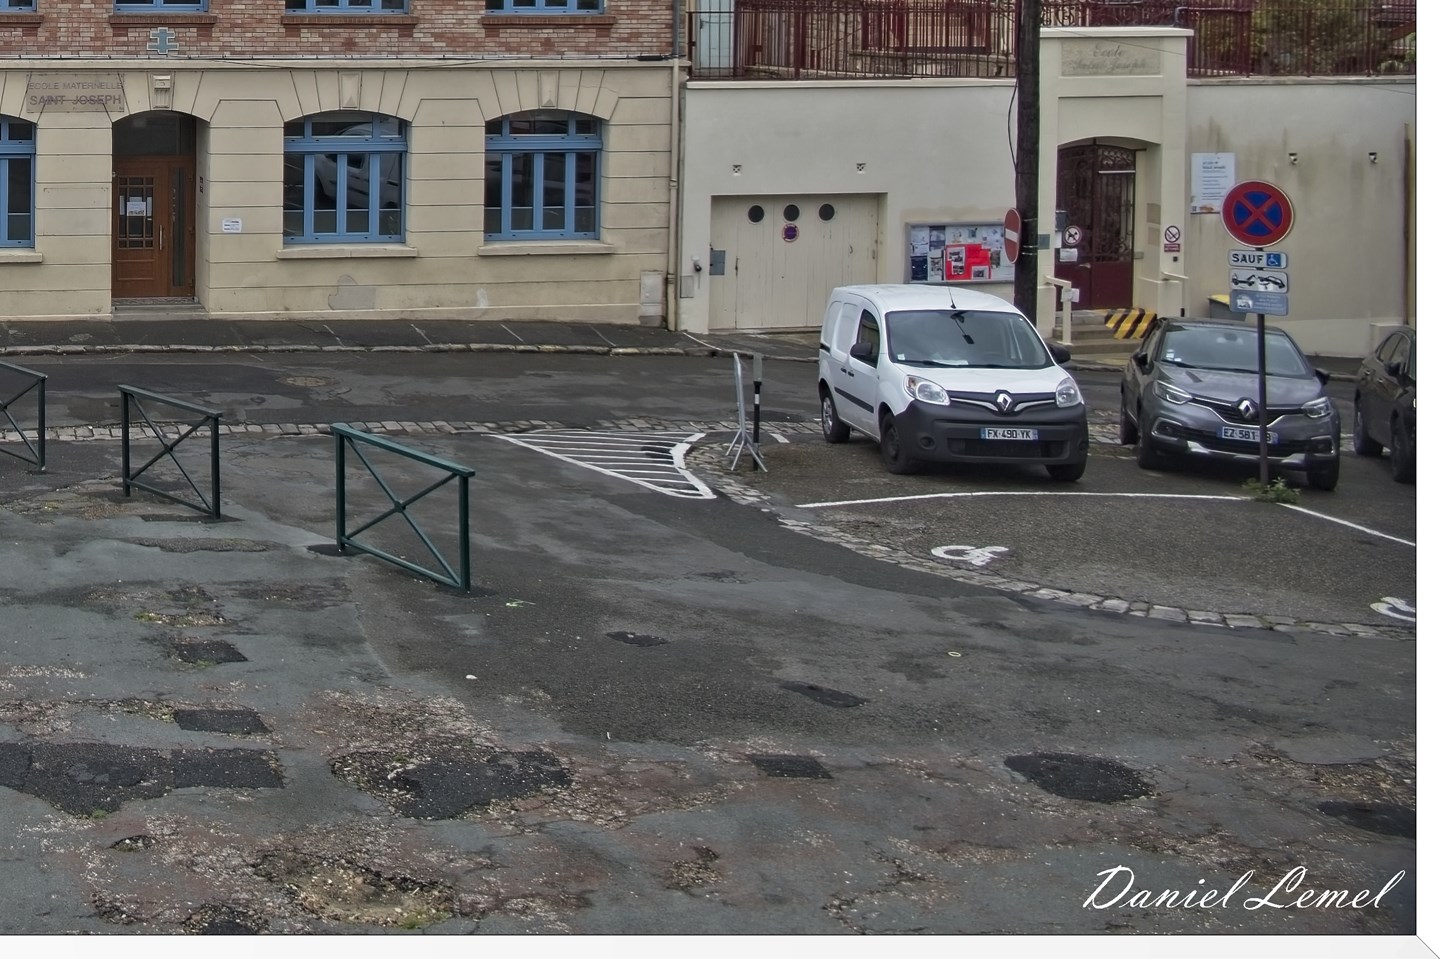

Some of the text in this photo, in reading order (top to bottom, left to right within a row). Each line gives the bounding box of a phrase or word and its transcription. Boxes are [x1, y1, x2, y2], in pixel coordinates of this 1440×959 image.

[62, 81, 122, 90] MATERNELLE
[29, 94, 122, 106] SAINT JOSEPH
[1232, 253, 1264, 264] SAUF
